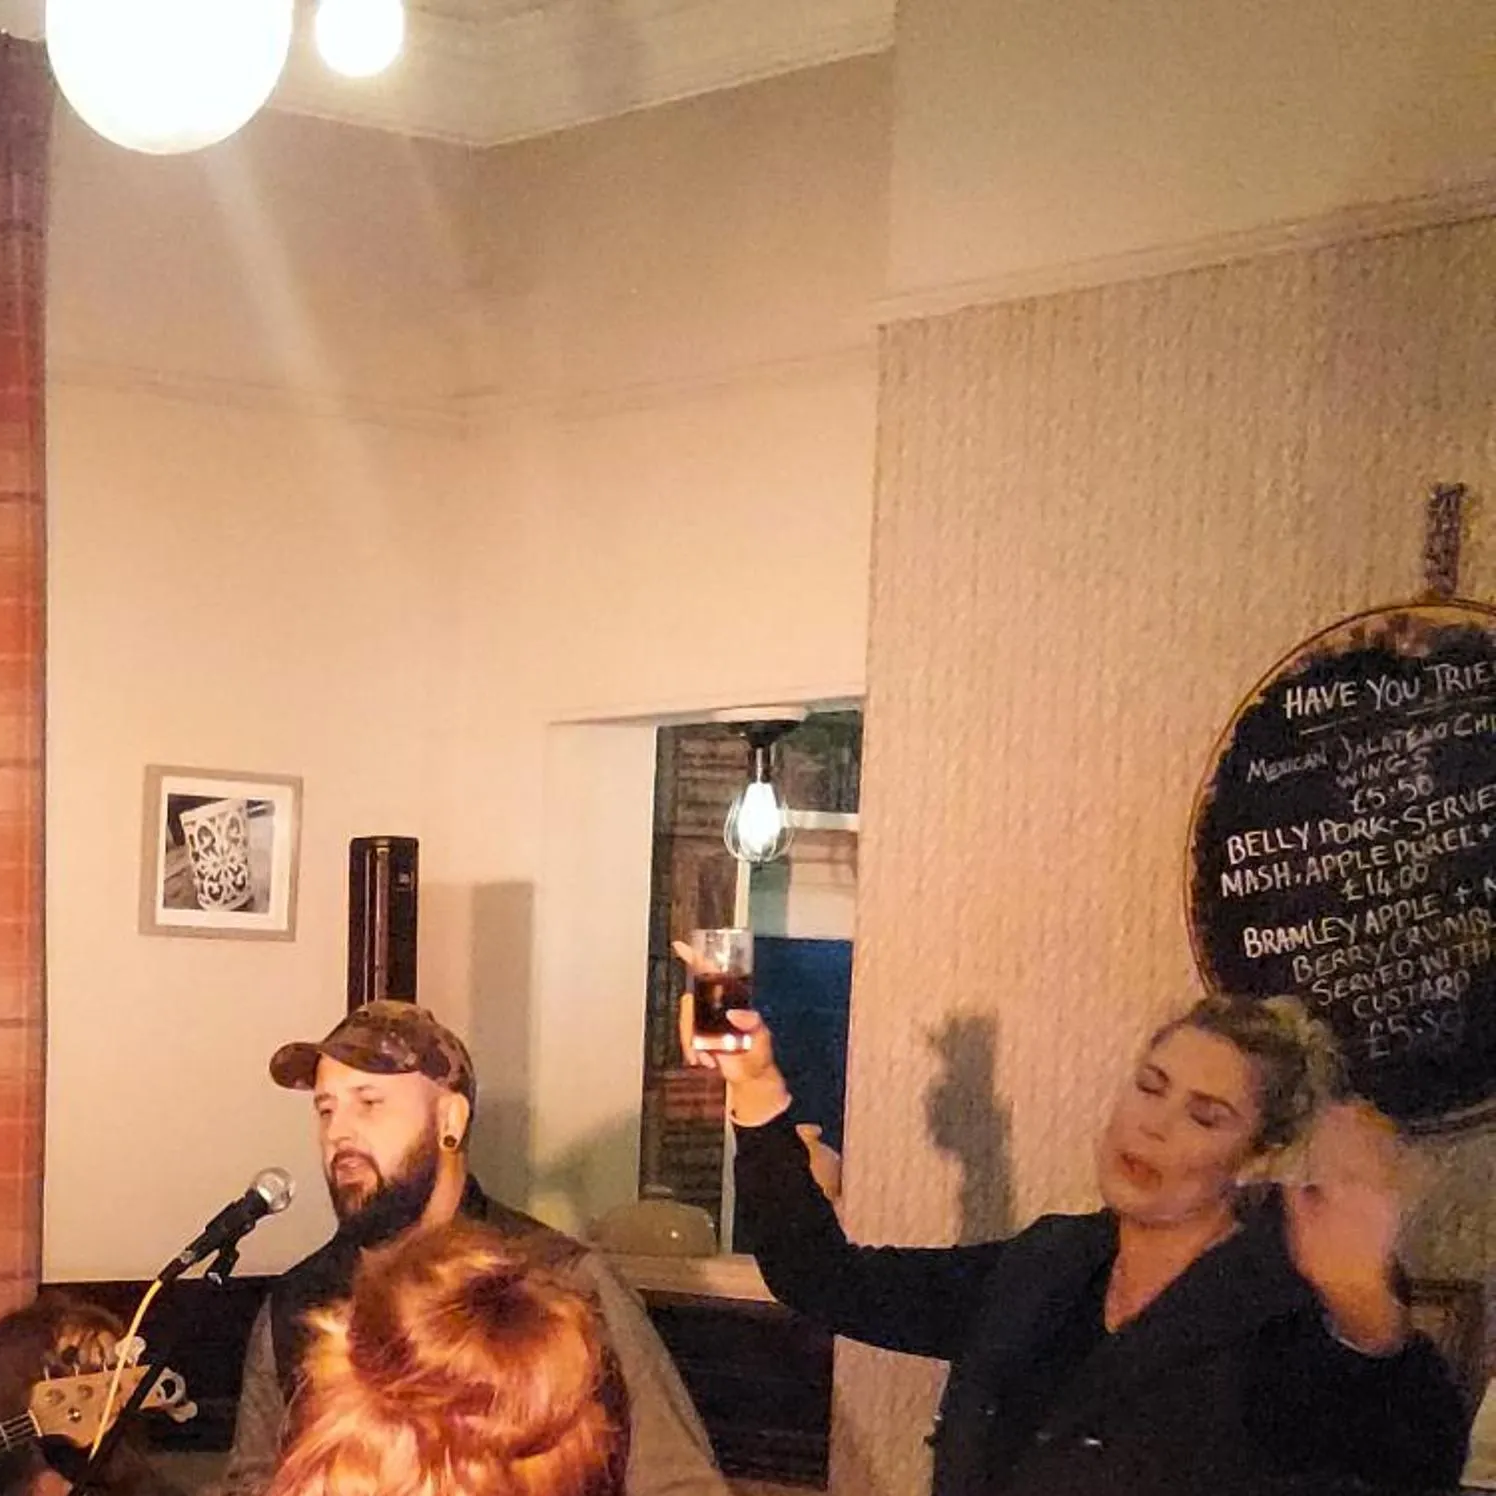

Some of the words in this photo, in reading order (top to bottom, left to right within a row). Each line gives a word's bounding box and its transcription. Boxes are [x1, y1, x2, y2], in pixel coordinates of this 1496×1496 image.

[1283, 682, 1357, 719] HAVE
[1367, 674, 1420, 711] YOU
[1424, 660, 1495, 694] TRIE
[1335, 747, 1427, 789] WINGS
[1226, 822, 1310, 864] BELLY
[1305, 845, 1392, 886] APPLE
[1242, 913, 1357, 959] BRAMLEY
[1364, 893, 1441, 935] APPLE
[1292, 941, 1386, 984] BERRY
[1352, 968, 1472, 1020] CUSTARD
